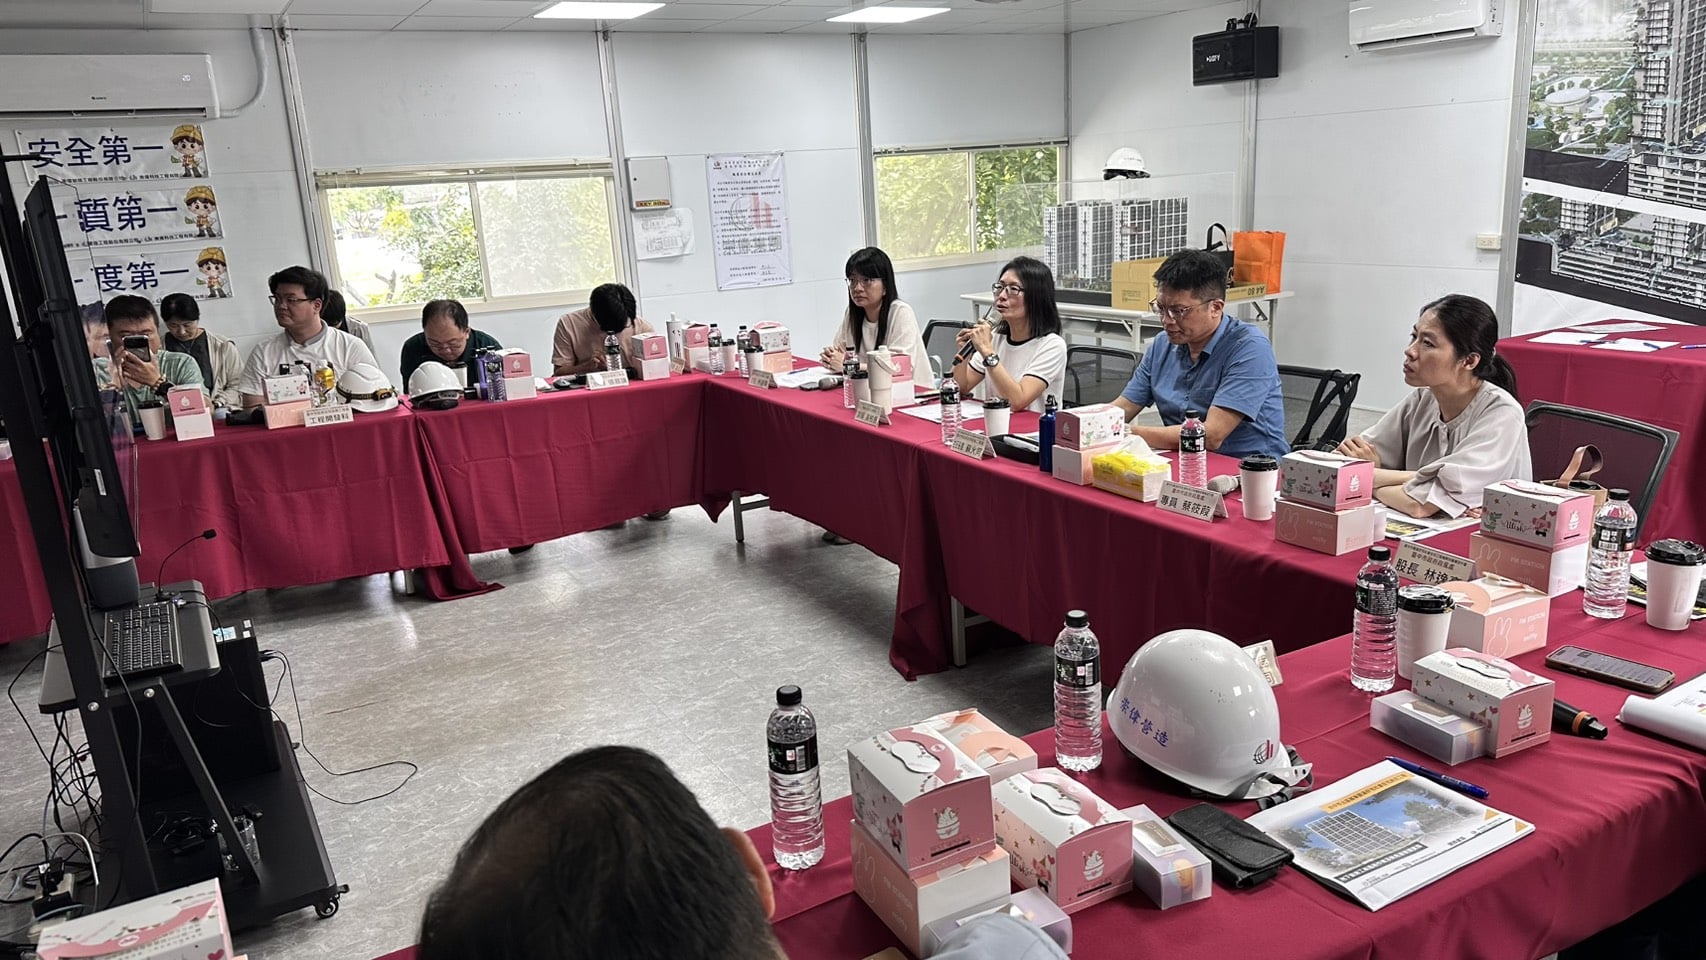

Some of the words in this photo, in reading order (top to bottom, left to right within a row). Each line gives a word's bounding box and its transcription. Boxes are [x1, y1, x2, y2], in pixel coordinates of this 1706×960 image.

[28, 135, 163, 168] 安全第一
[97, 261, 189, 293] 度第一
[1160, 494, 1178, 509] 專員
[1395, 558, 1420, 577] 股長
